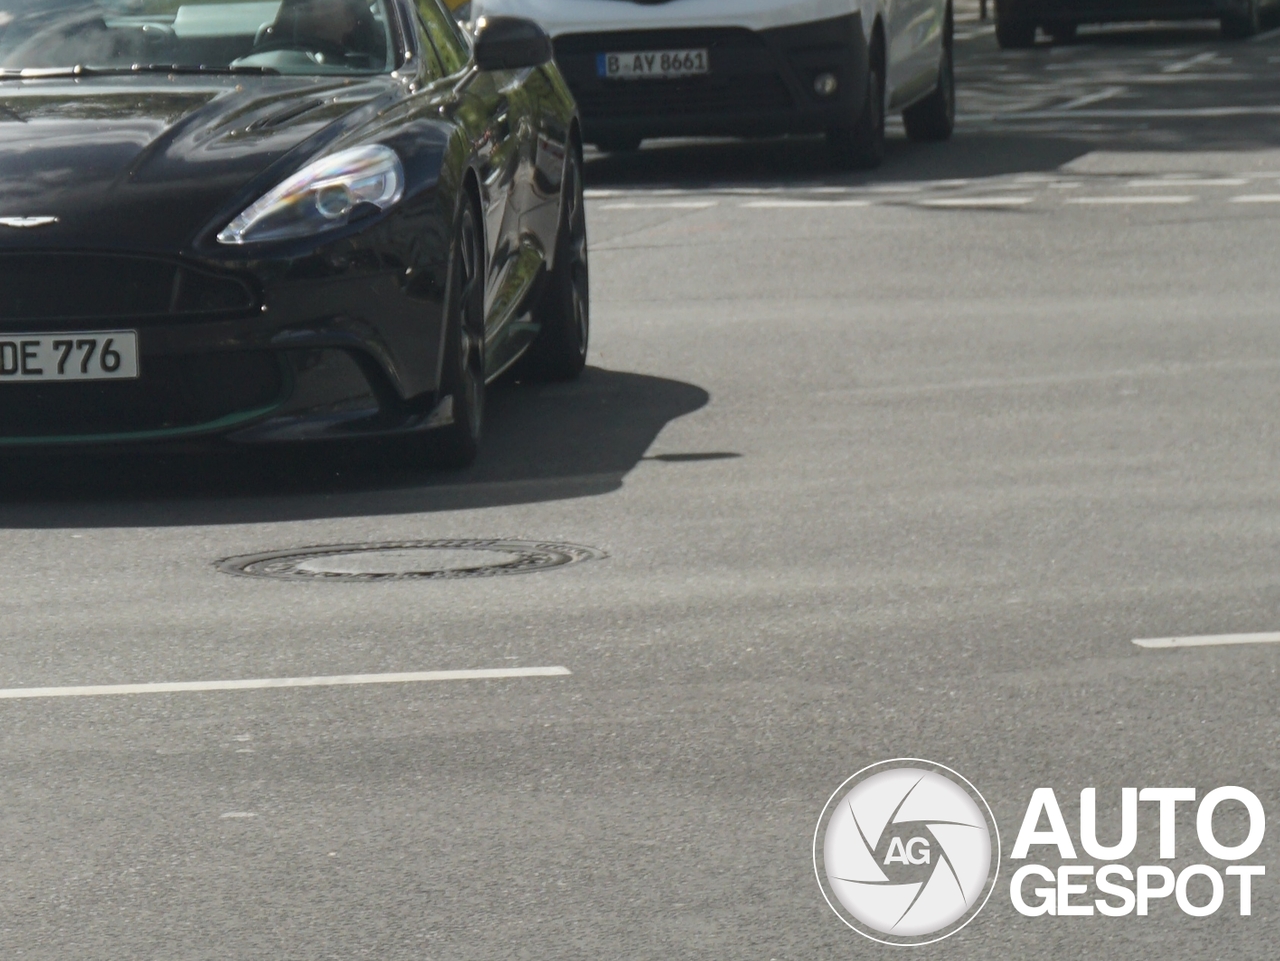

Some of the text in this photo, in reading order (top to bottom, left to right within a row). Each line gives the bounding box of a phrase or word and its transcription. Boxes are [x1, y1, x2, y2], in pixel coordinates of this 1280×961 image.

[608, 53, 705, 73] B AY 8661
[52, 338, 121, 374] 776
